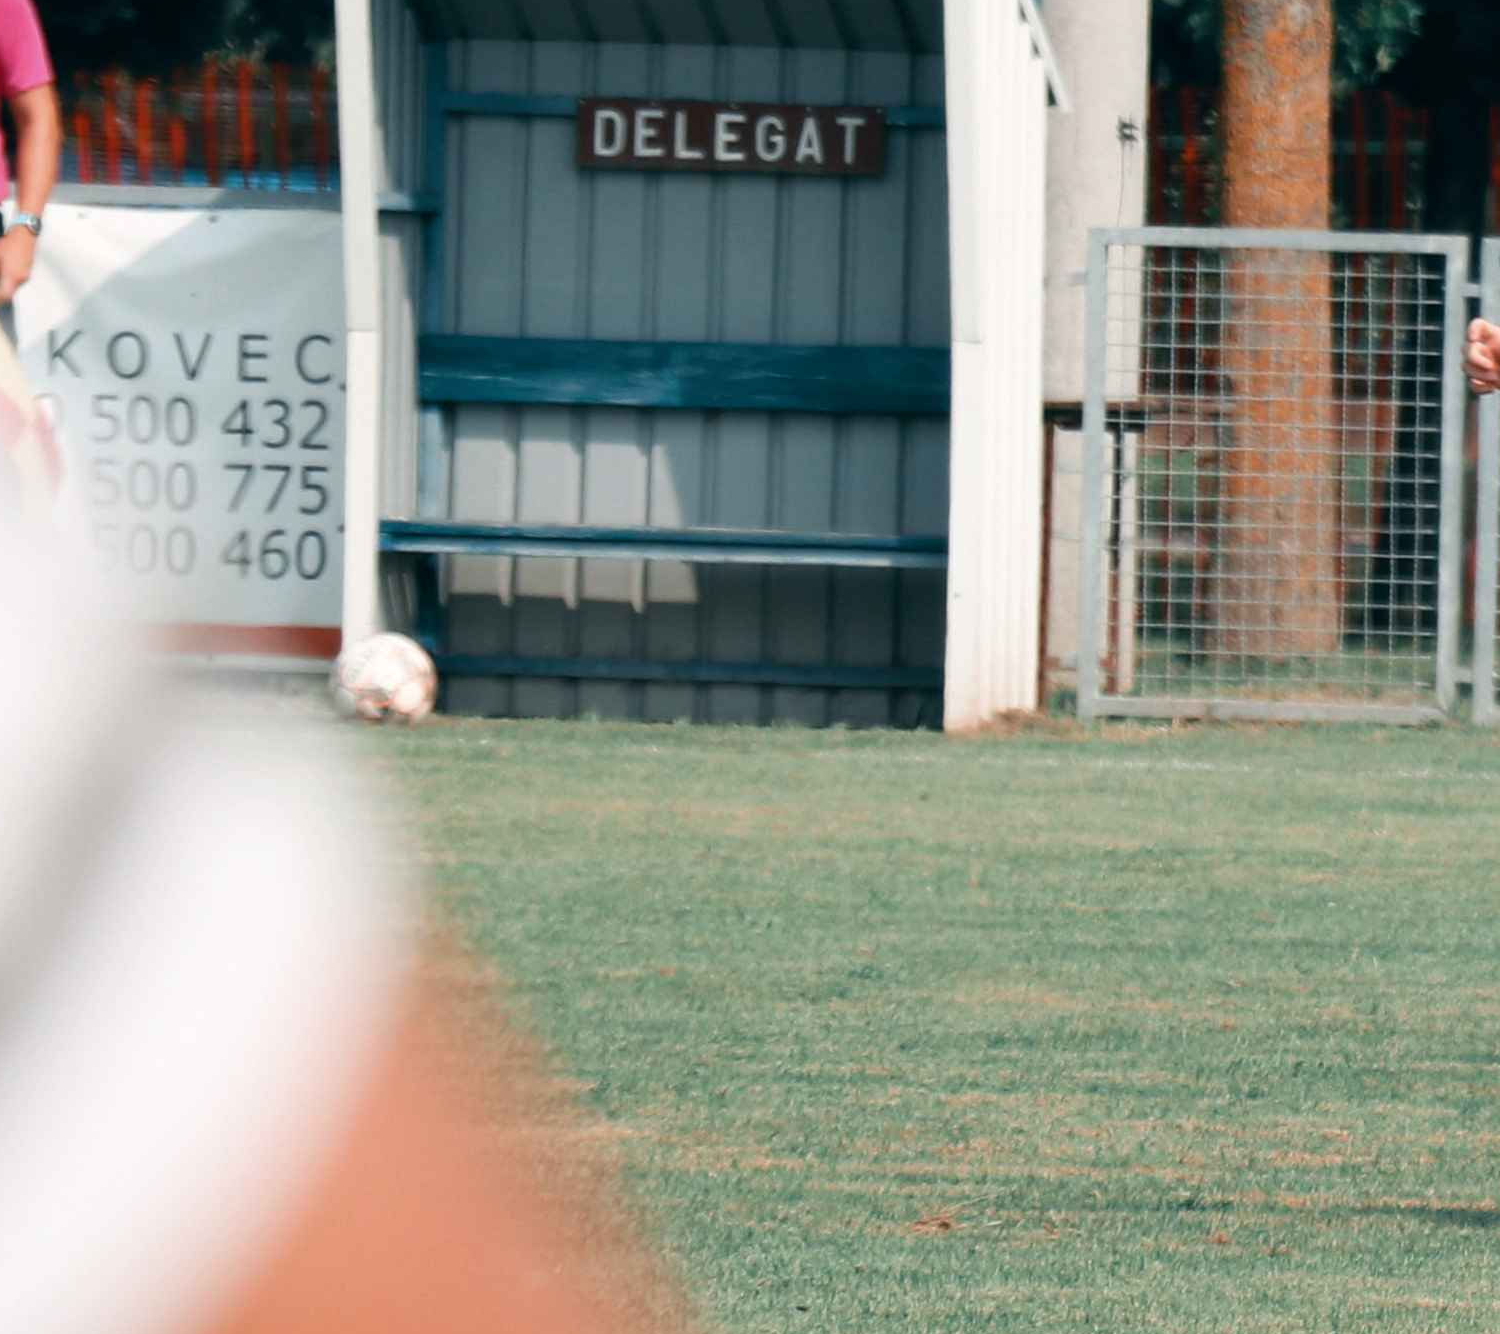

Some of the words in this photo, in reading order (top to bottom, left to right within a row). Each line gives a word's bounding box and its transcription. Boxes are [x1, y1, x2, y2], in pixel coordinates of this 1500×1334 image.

[593, 109, 866, 165] DELEGAT
[47, 330, 334, 384] KOVEC
[221, 400, 329, 450] 432
[223, 464, 329, 516] 775
[221, 529, 327, 580] 460
